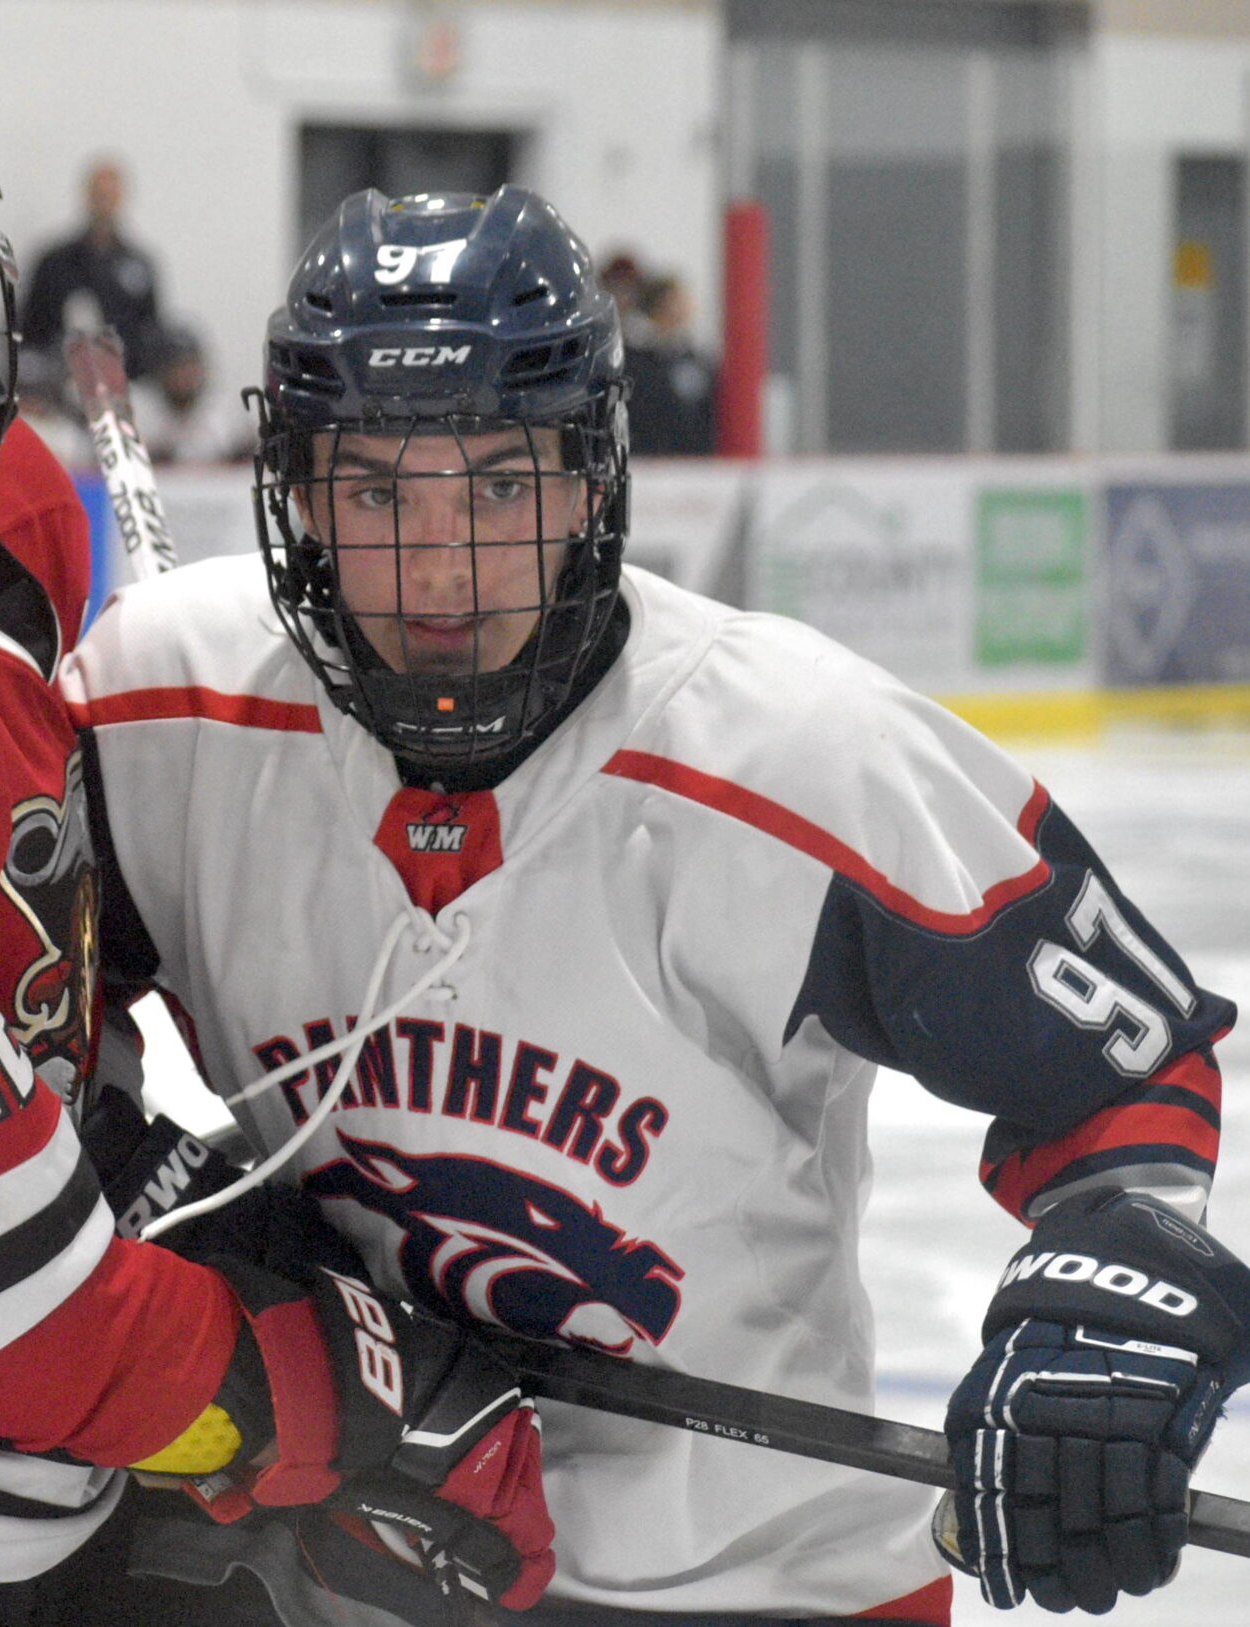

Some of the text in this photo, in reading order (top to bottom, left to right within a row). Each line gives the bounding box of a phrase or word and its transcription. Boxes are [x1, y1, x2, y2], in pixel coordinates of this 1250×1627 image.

[374, 238, 467, 285] 97
[368, 344, 472, 367] CCM
[406, 823, 468, 853] WM
[1026, 867, 1198, 1078] 97
[252, 1014, 670, 1188] PANTHERS
[685, 1417, 709, 1431] P28
[714, 1424, 748, 1440] FLEX
